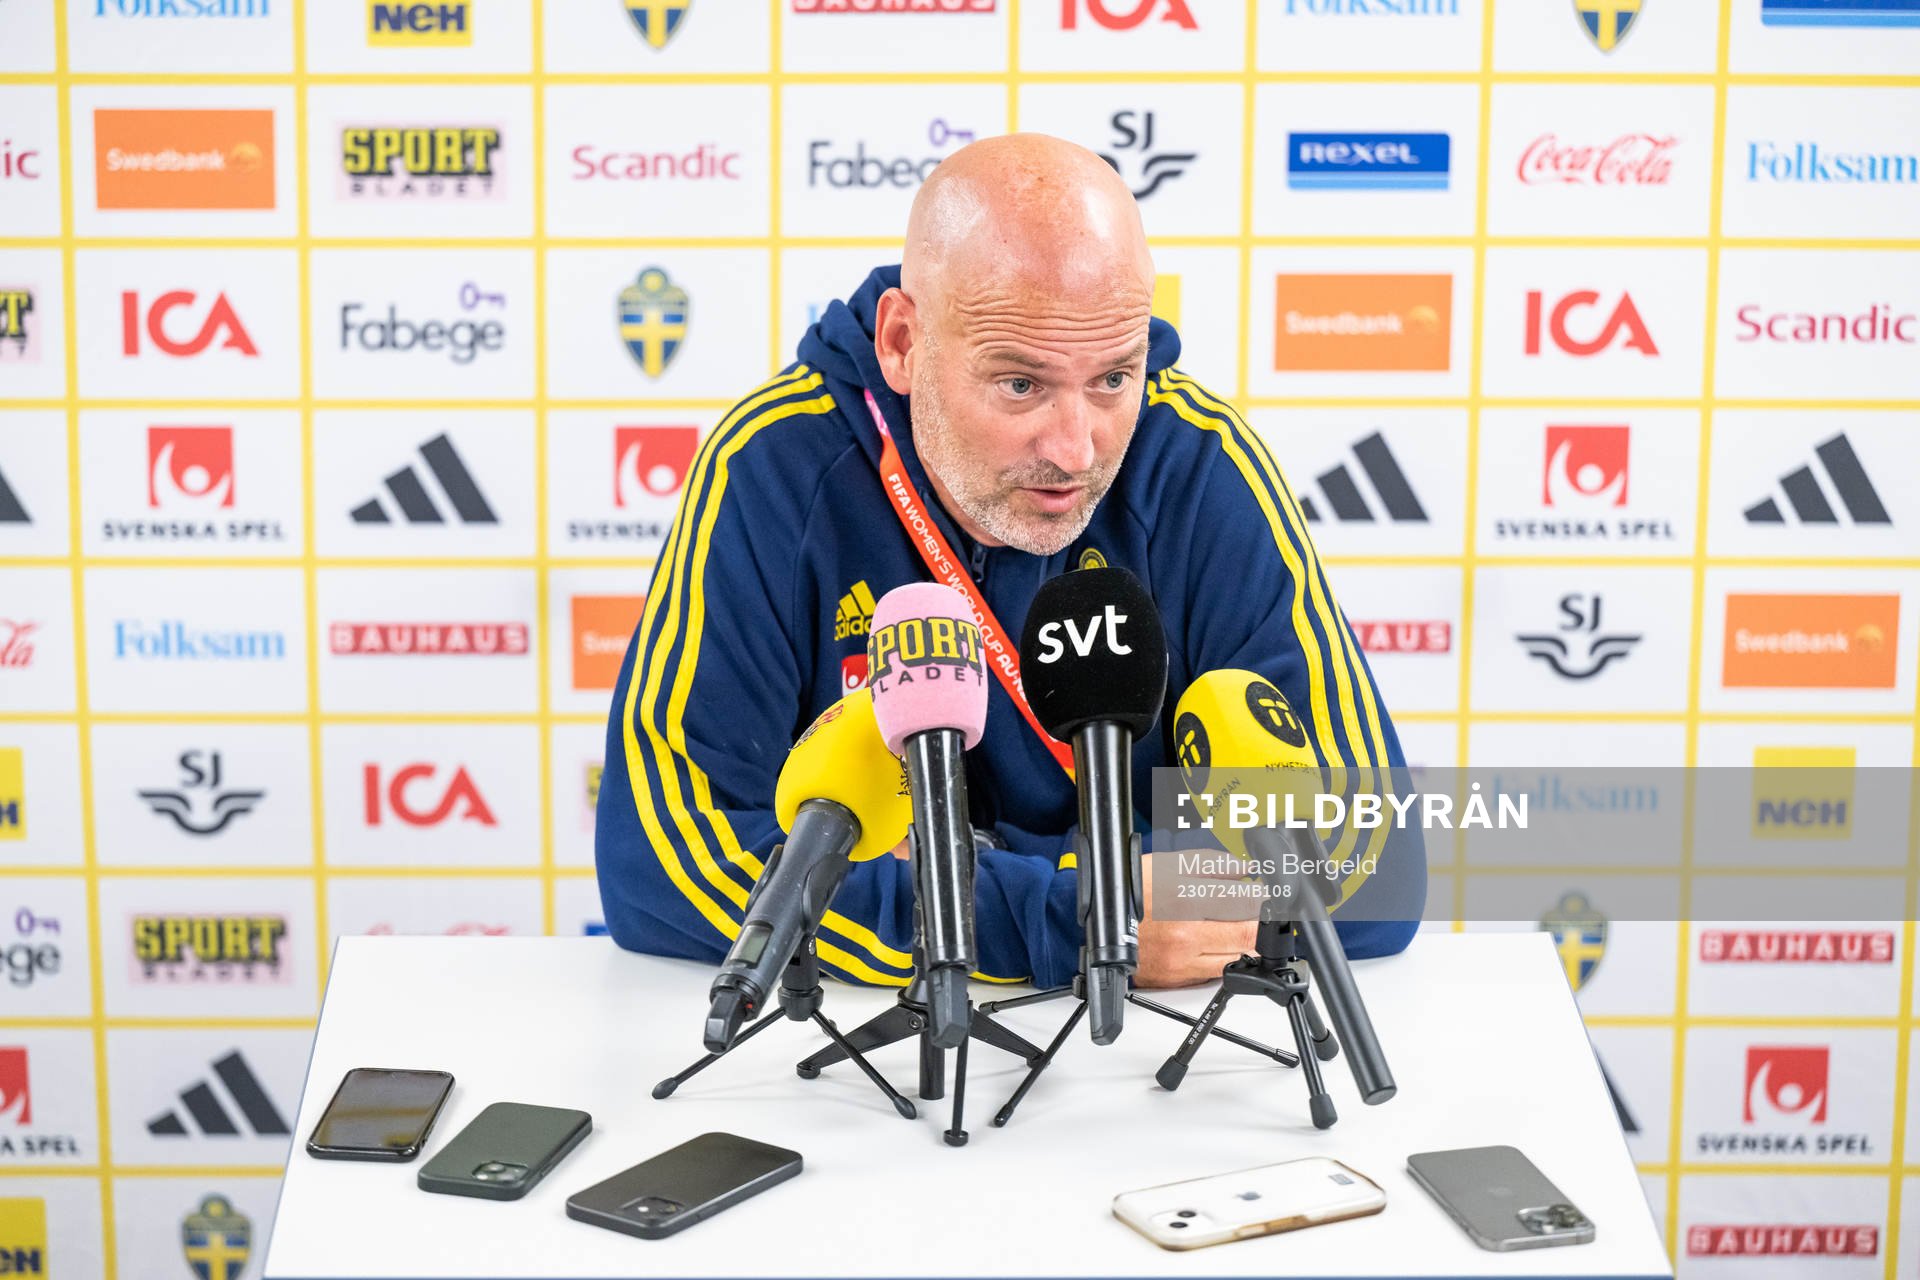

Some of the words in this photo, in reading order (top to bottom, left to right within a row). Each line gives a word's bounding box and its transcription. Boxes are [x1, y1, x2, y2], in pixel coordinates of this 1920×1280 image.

[1112, 111, 1155, 152] SJ
[106, 148, 225, 171] Swedbank
[342, 127, 500, 178] SPORT
[572, 144, 741, 180] Scandic
[808, 141, 941, 189] Fabe
[1746, 142, 1919, 182] Folksam
[351, 180, 493, 196] BLADET
[122, 291, 260, 357] ICA
[341, 303, 504, 364] Fabege
[1286, 312, 1402, 335] Swedbank
[1524, 291, 1660, 357] ICA
[1736, 305, 1917, 343] Scandic
[103, 522, 216, 540] SVENSKA
[229, 522, 285, 540] SPEL
[569, 522, 666, 540] SVENSK
[1495, 520, 1608, 539] SVENSKA
[1618, 521, 1675, 540] SPEL
[887, 473, 912, 509] FIFA
[905, 504, 954, 575] WOMEN'S
[980, 625, 1005, 654] CUP
[1559, 593, 1602, 632] SJ
[114, 621, 285, 661] Folksam
[332, 624, 528, 653] BAUHAUS
[867, 616, 985, 689] SPORT
[1037, 604, 1133, 664] svt
[1735, 629, 1849, 653] Swedbank
[179, 750, 222, 788] SJ
[363, 764, 498, 826] ICA
[1492, 775, 1659, 813] Flksam
[135, 917, 286, 967] SPORT
[1702, 933, 1892, 961] BAUHAUS
[23, 1136, 80, 1156] SPEL
[1698, 1134, 1808, 1154] SVENSKA
[1817, 1135, 1873, 1155] SPEL
[1688, 1226, 1878, 1256] BAUHAUS
